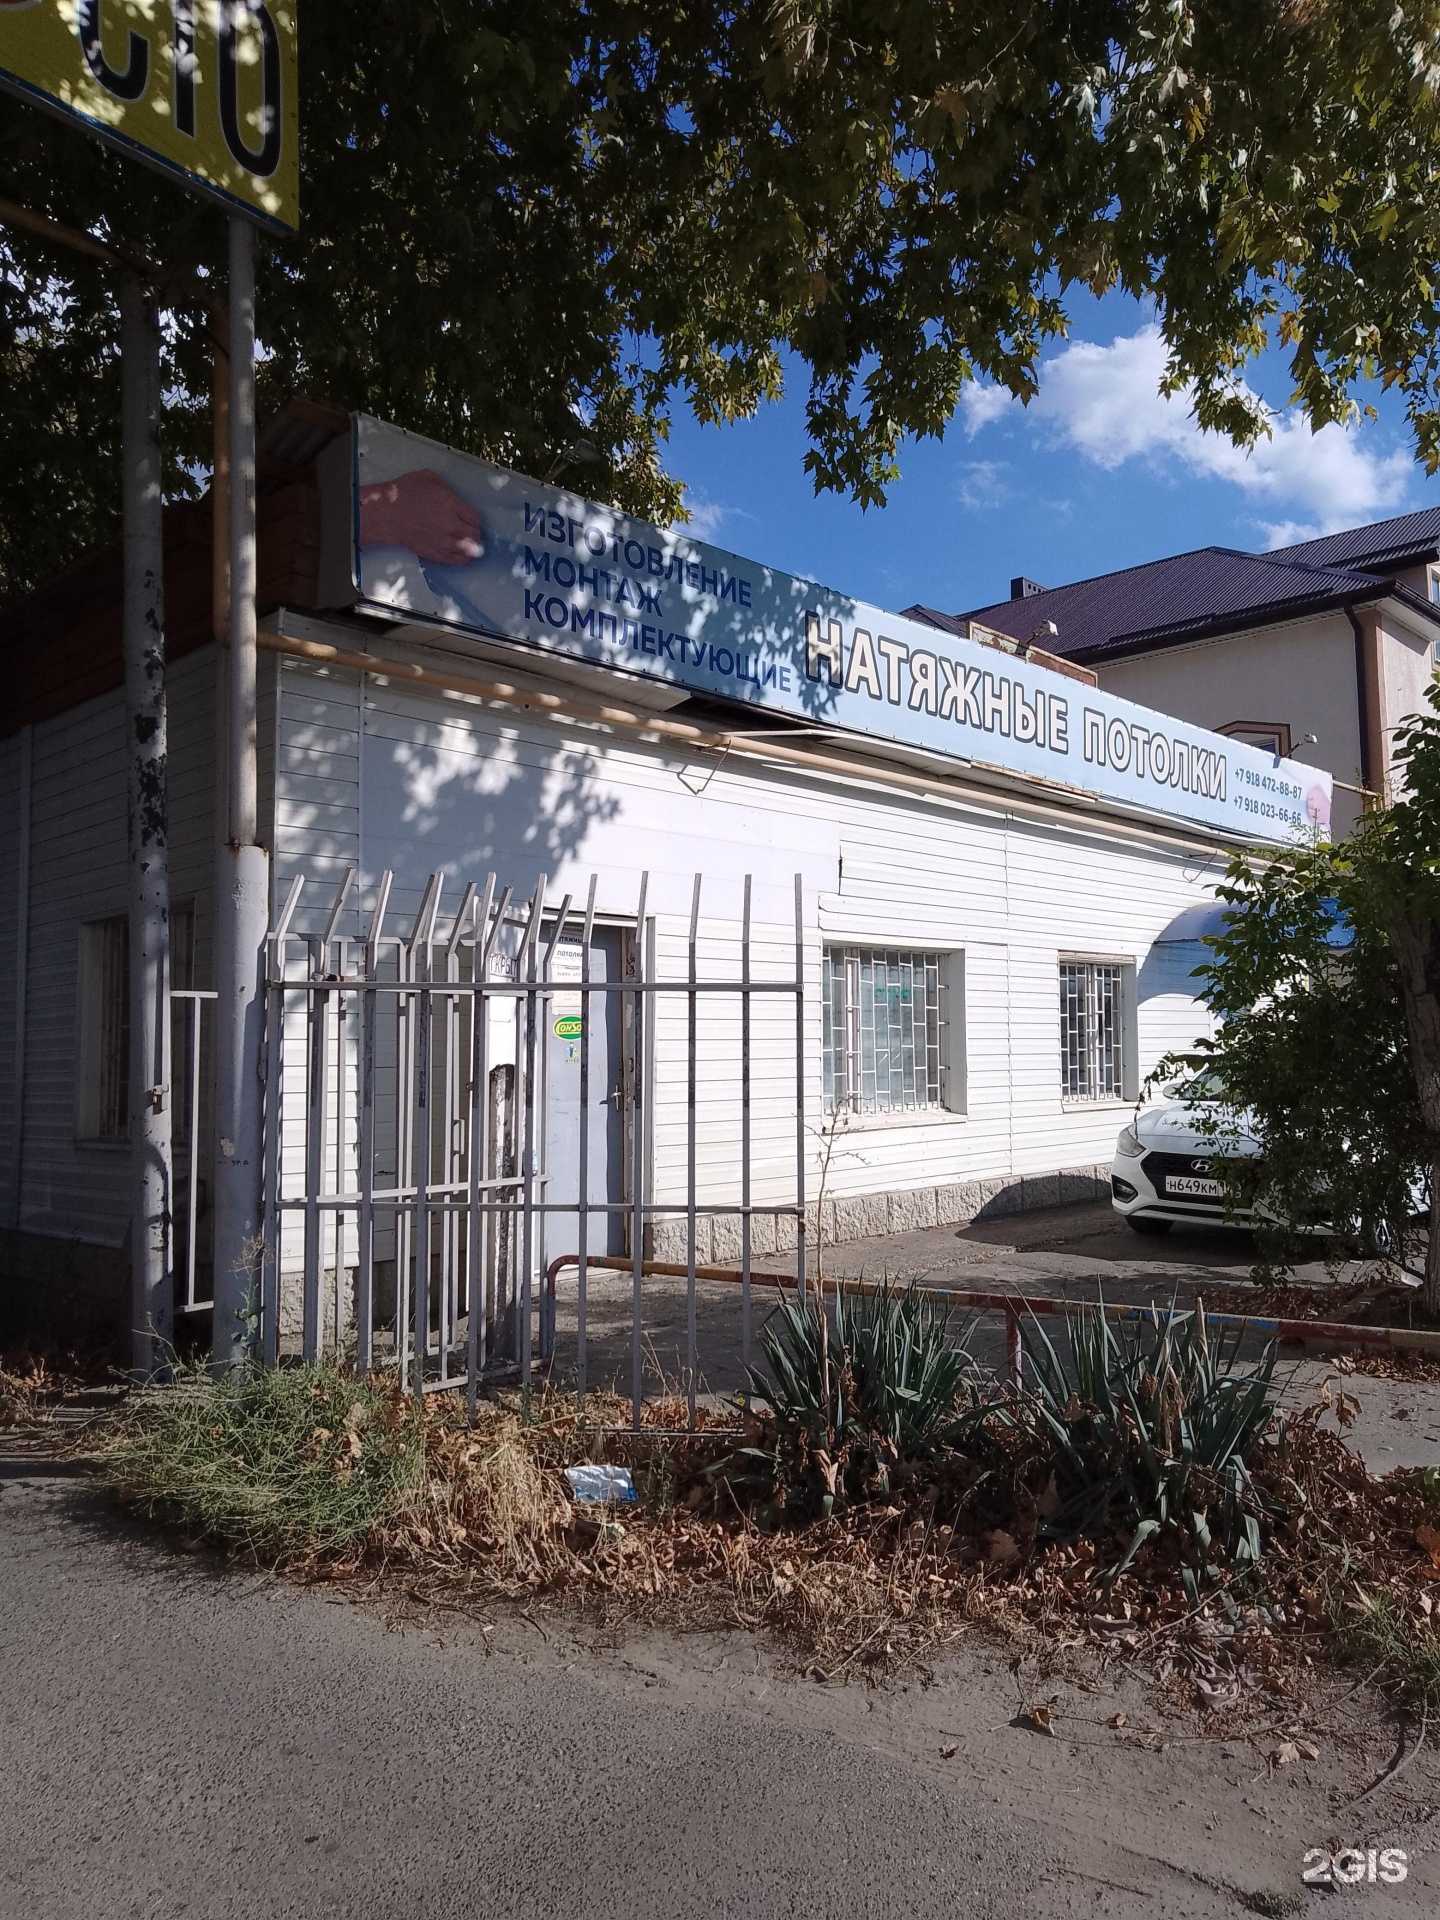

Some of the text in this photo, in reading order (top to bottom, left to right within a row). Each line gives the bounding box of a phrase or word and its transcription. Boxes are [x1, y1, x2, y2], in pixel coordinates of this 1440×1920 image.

[523, 502, 753, 608] ИЗГОТОВЛЕНИЕ
[523, 545, 663, 617] МОНТАЖ
[523, 588, 792, 693] КОМПЛЕКТУЮЩИЕ
[805, 610, 1227, 801] НАТЯЖНЫЕ ПОТОЛКИ
[1233, 795, 1302, 826] +7 918 023-66-66
[1235, 768, 1244, 782] +7
[1245, 770, 1260, 787] 918
